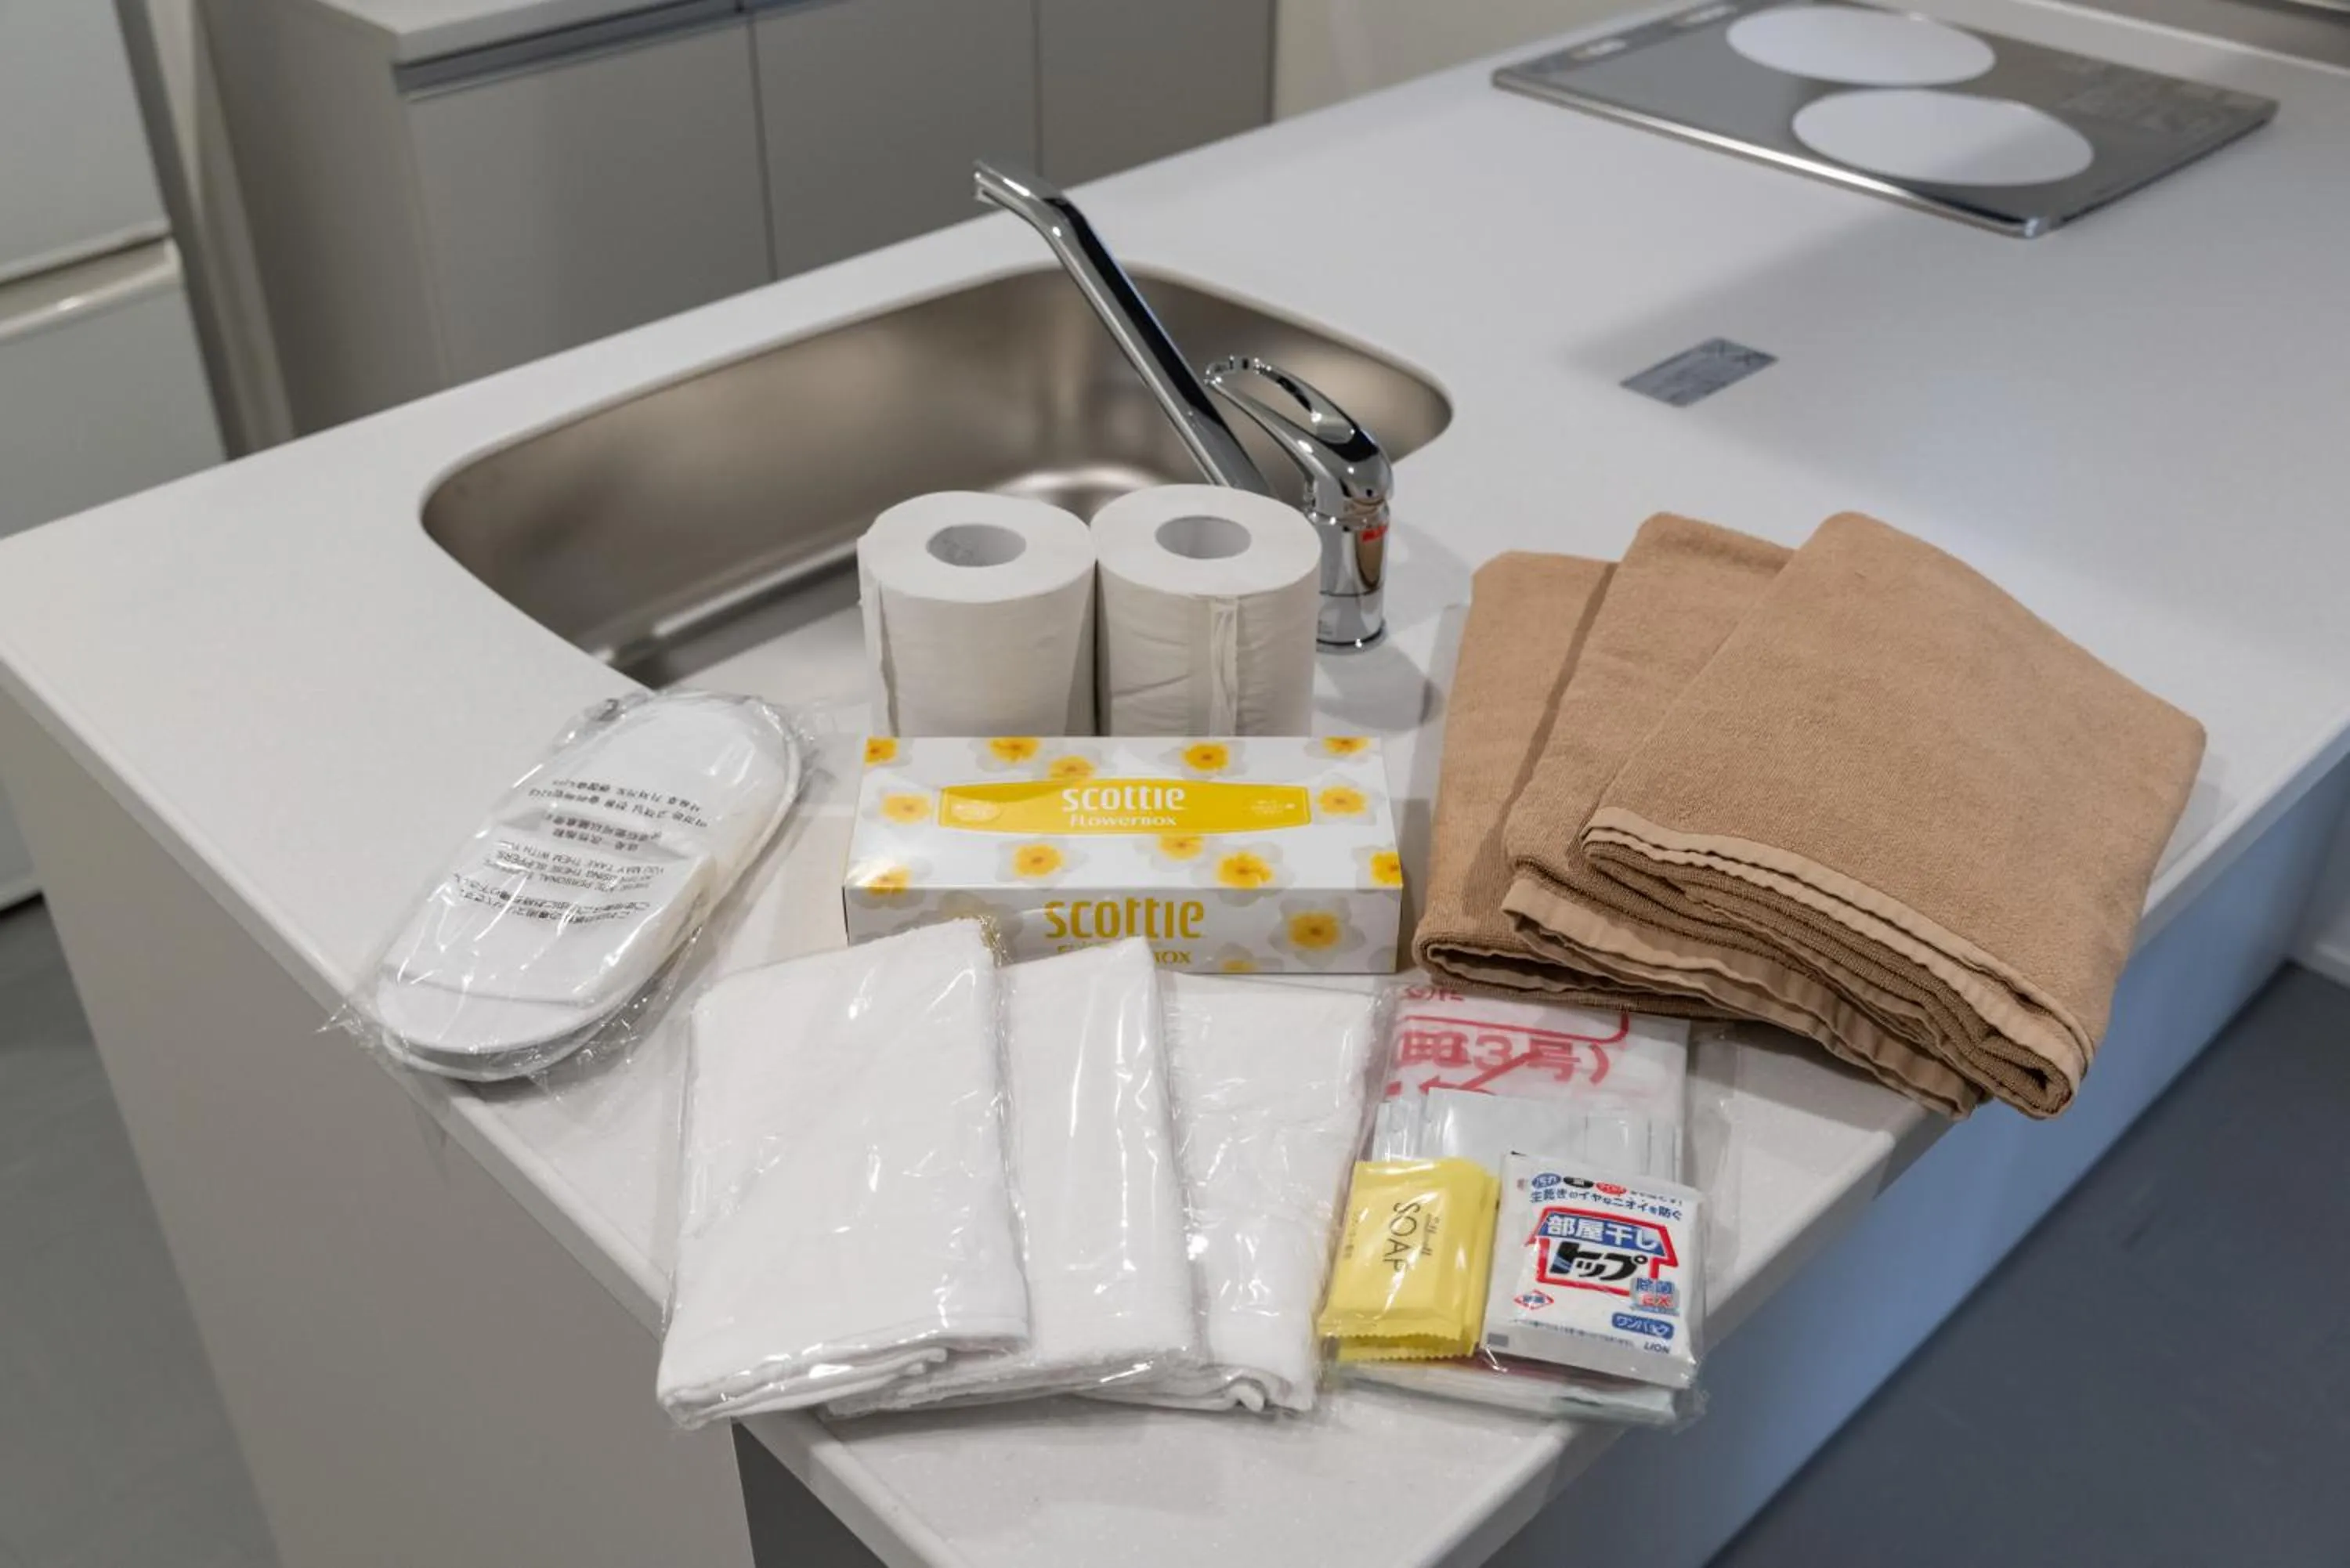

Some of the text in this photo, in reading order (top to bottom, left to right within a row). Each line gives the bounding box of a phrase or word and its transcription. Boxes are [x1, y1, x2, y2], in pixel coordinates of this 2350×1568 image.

[1061, 786, 1186, 811] scottie
[1043, 896, 1205, 940] scottie
[1546, 1215, 1661, 1251] 部屋干し
[1549, 1241, 1648, 1281] トップ
[1644, 1341, 1670, 1354] LION
